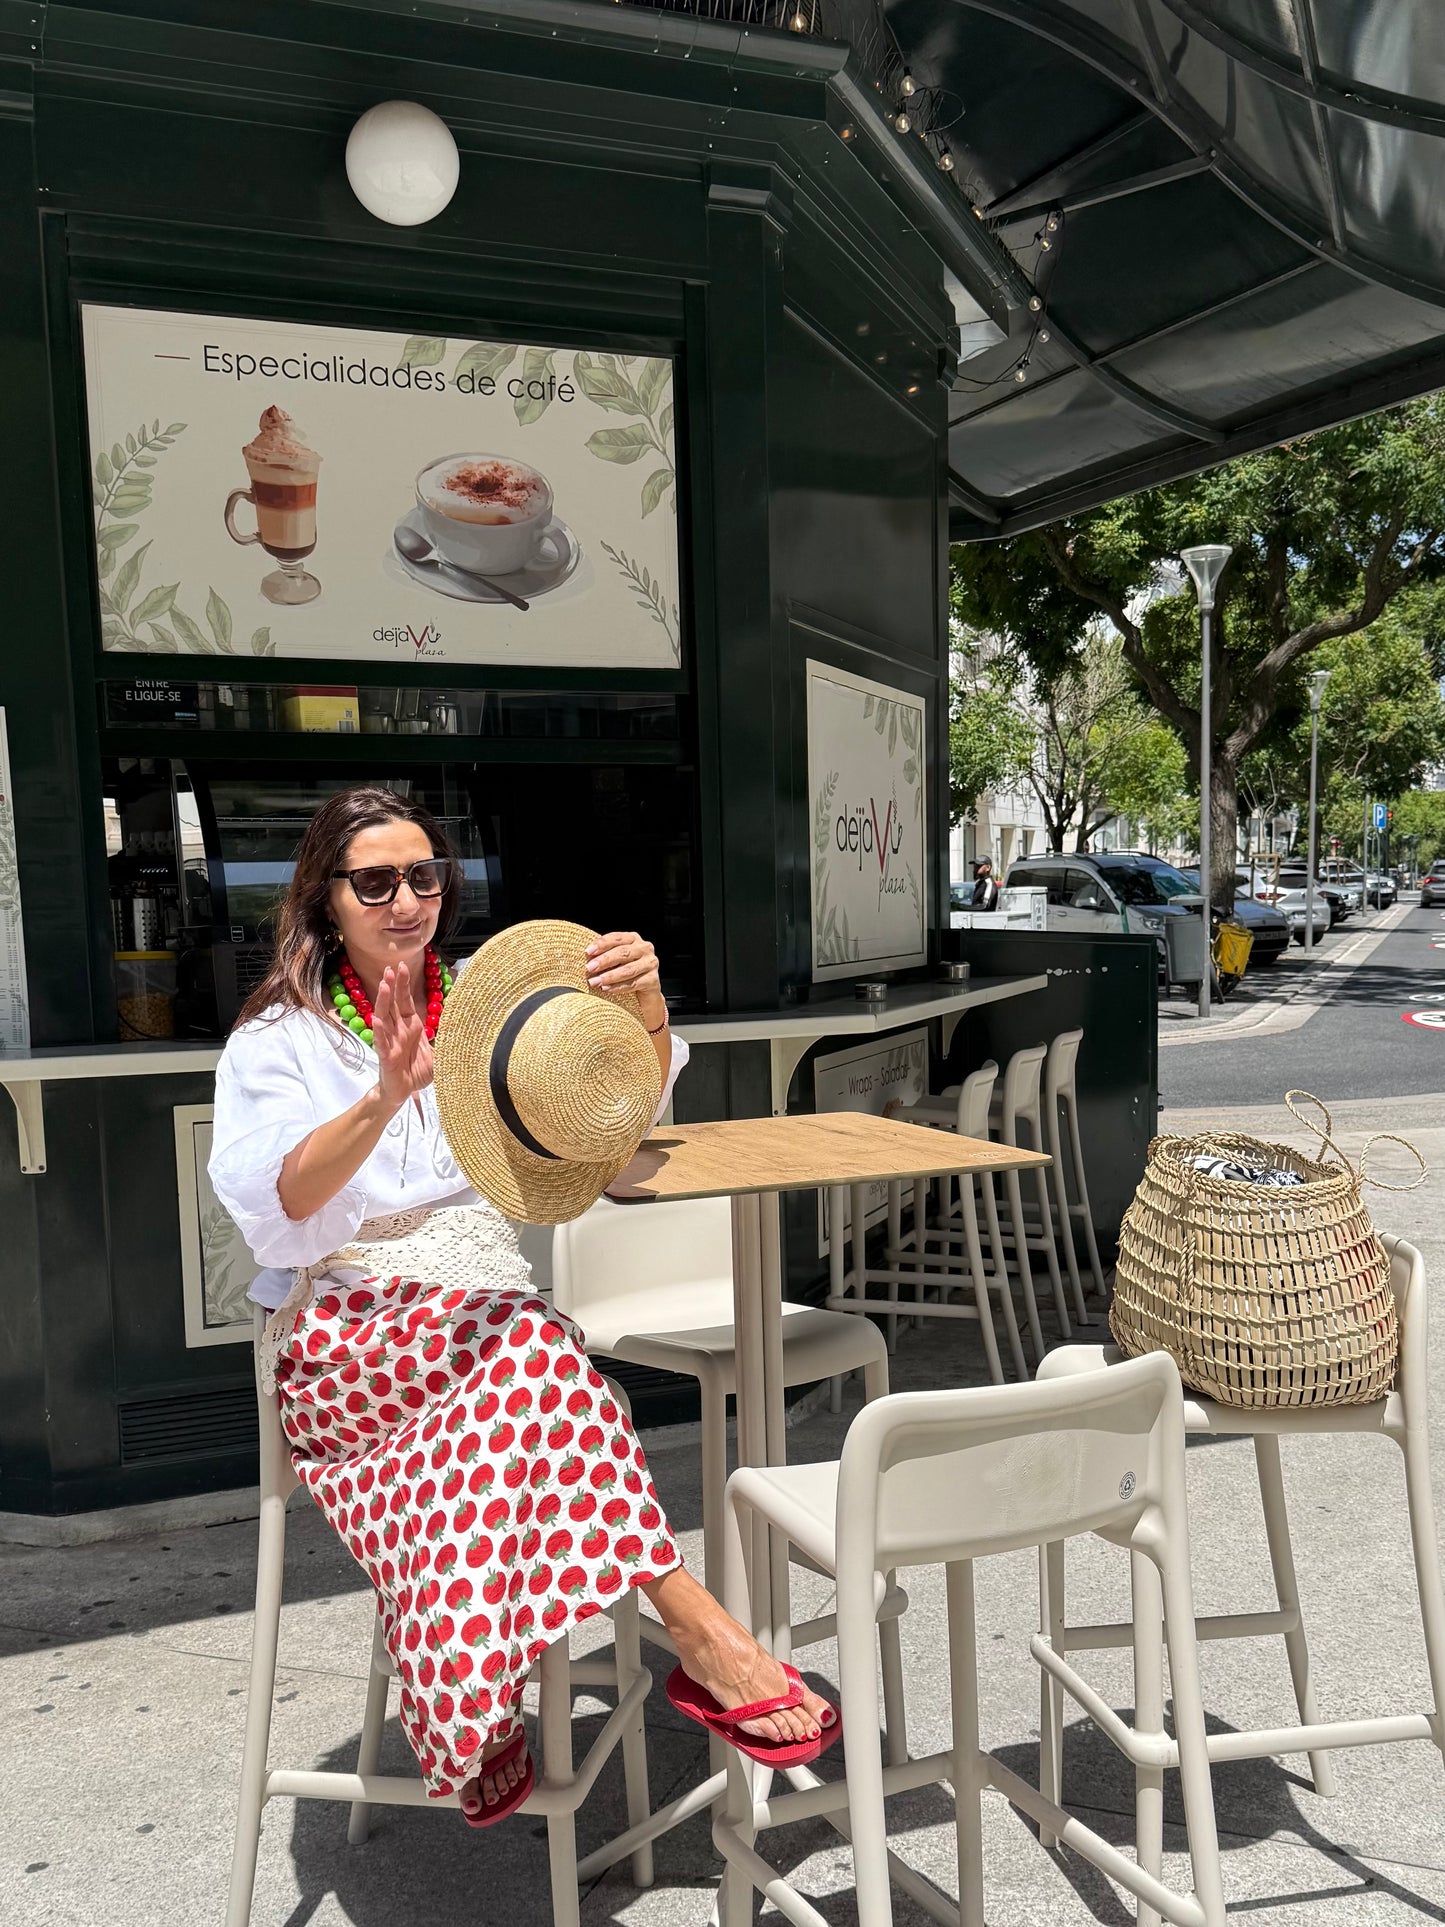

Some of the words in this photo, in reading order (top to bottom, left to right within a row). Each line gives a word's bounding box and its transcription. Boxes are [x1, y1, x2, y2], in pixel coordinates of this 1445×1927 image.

[203, 344, 446, 392] Especialidades
[455, 369, 497, 396] de
[507, 375, 576, 403] café
[125, 690, 133, 701] E
[134, 690, 182, 702] LIGUE-SE
[848, 1075, 873, 1098] Wraps
